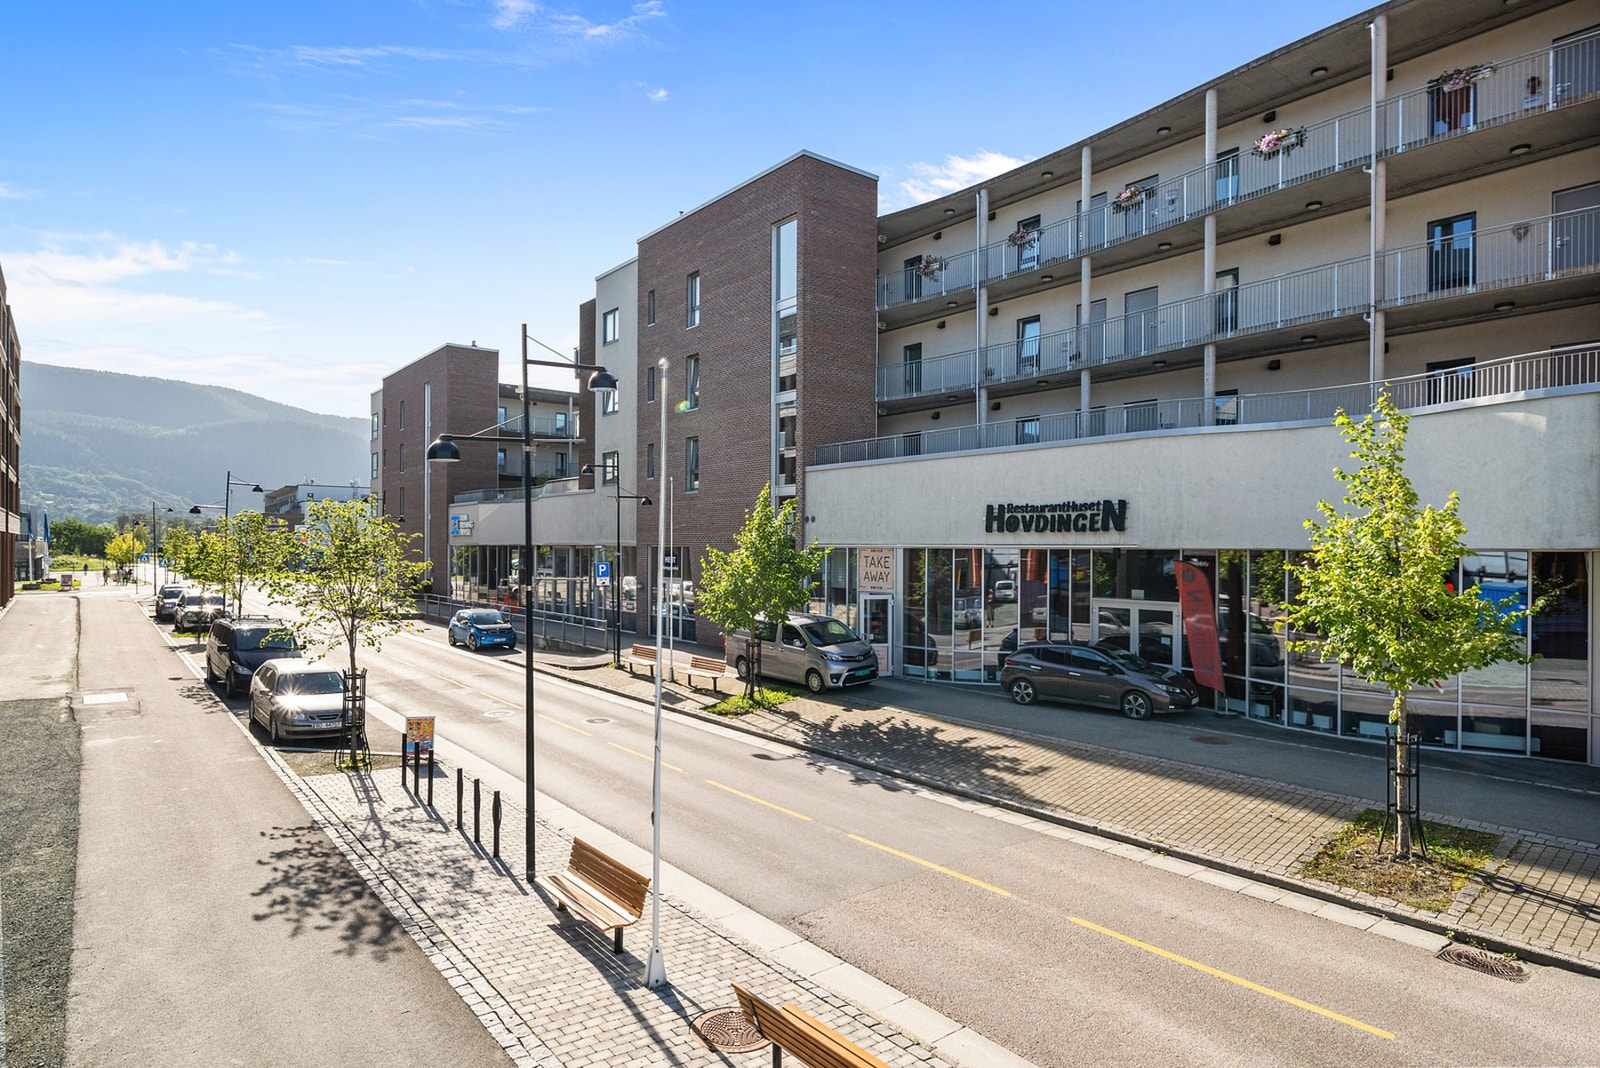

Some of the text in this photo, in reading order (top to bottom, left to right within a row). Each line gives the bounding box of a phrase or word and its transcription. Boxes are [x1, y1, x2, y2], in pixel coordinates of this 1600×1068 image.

[1006, 500, 1101, 514] RestaurantHuset
[985, 499, 1127, 533] HØVDINGEN
[864, 556, 890, 568] TAKE
[600, 564, 606, 576] P
[864, 571, 890, 582] AWAY
